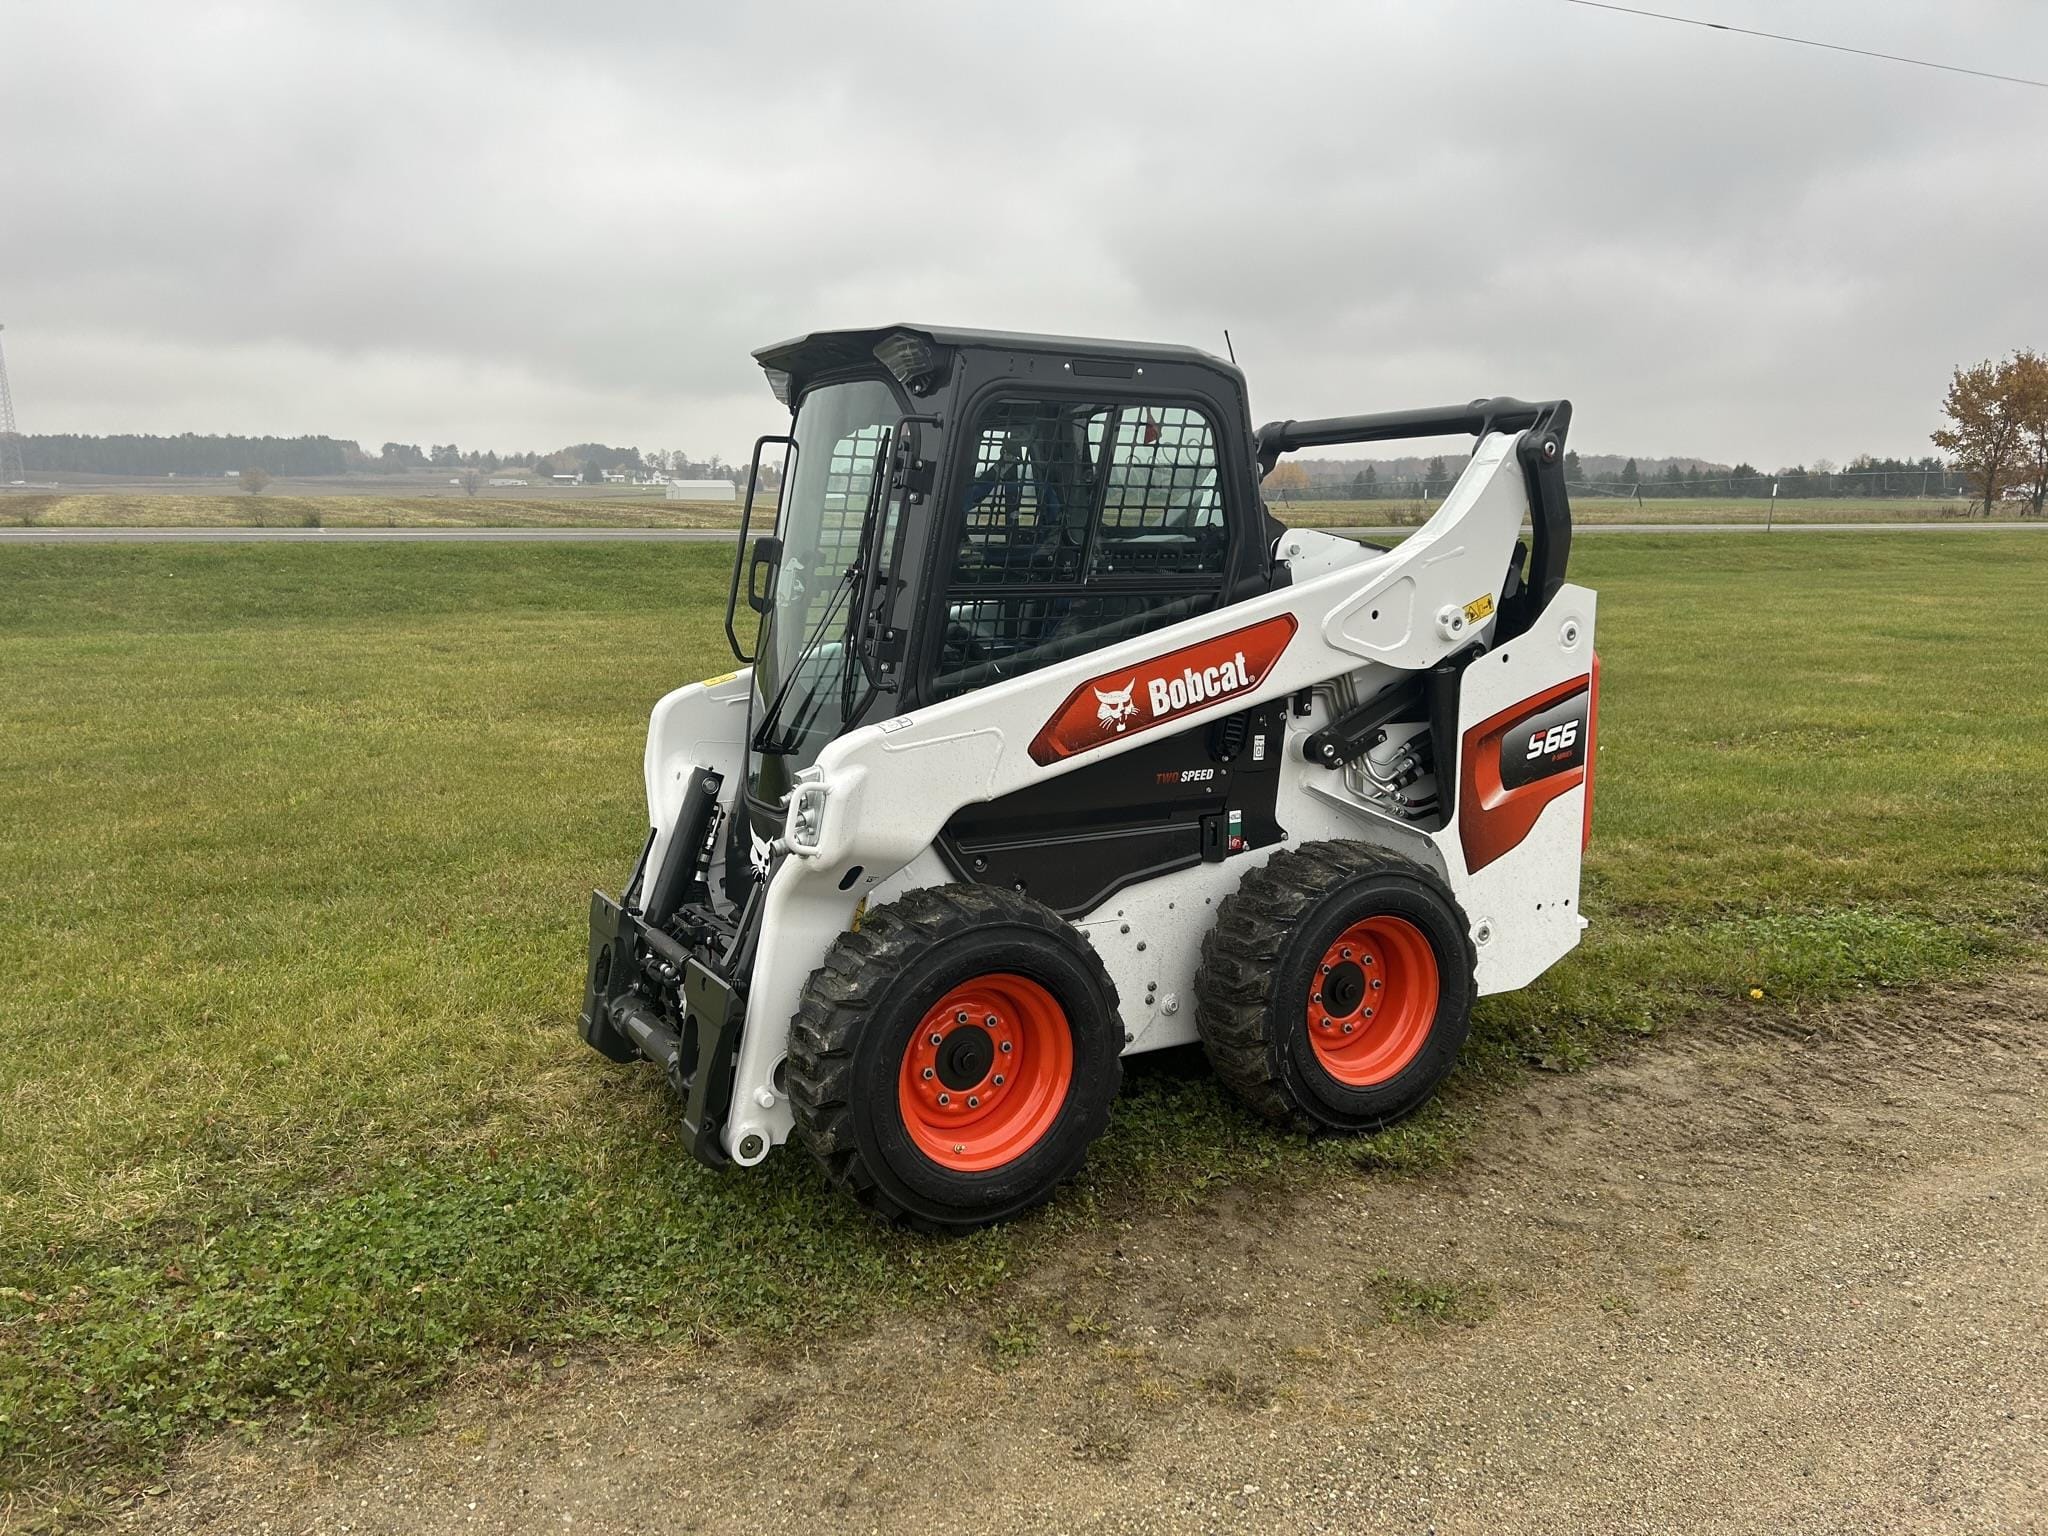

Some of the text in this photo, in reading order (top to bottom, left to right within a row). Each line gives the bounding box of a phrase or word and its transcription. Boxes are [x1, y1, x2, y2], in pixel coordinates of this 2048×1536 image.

[1148, 651, 1249, 717] Bobcat
[1526, 719, 1579, 760] S66
[1156, 768, 1214, 784] TWO SPEED
